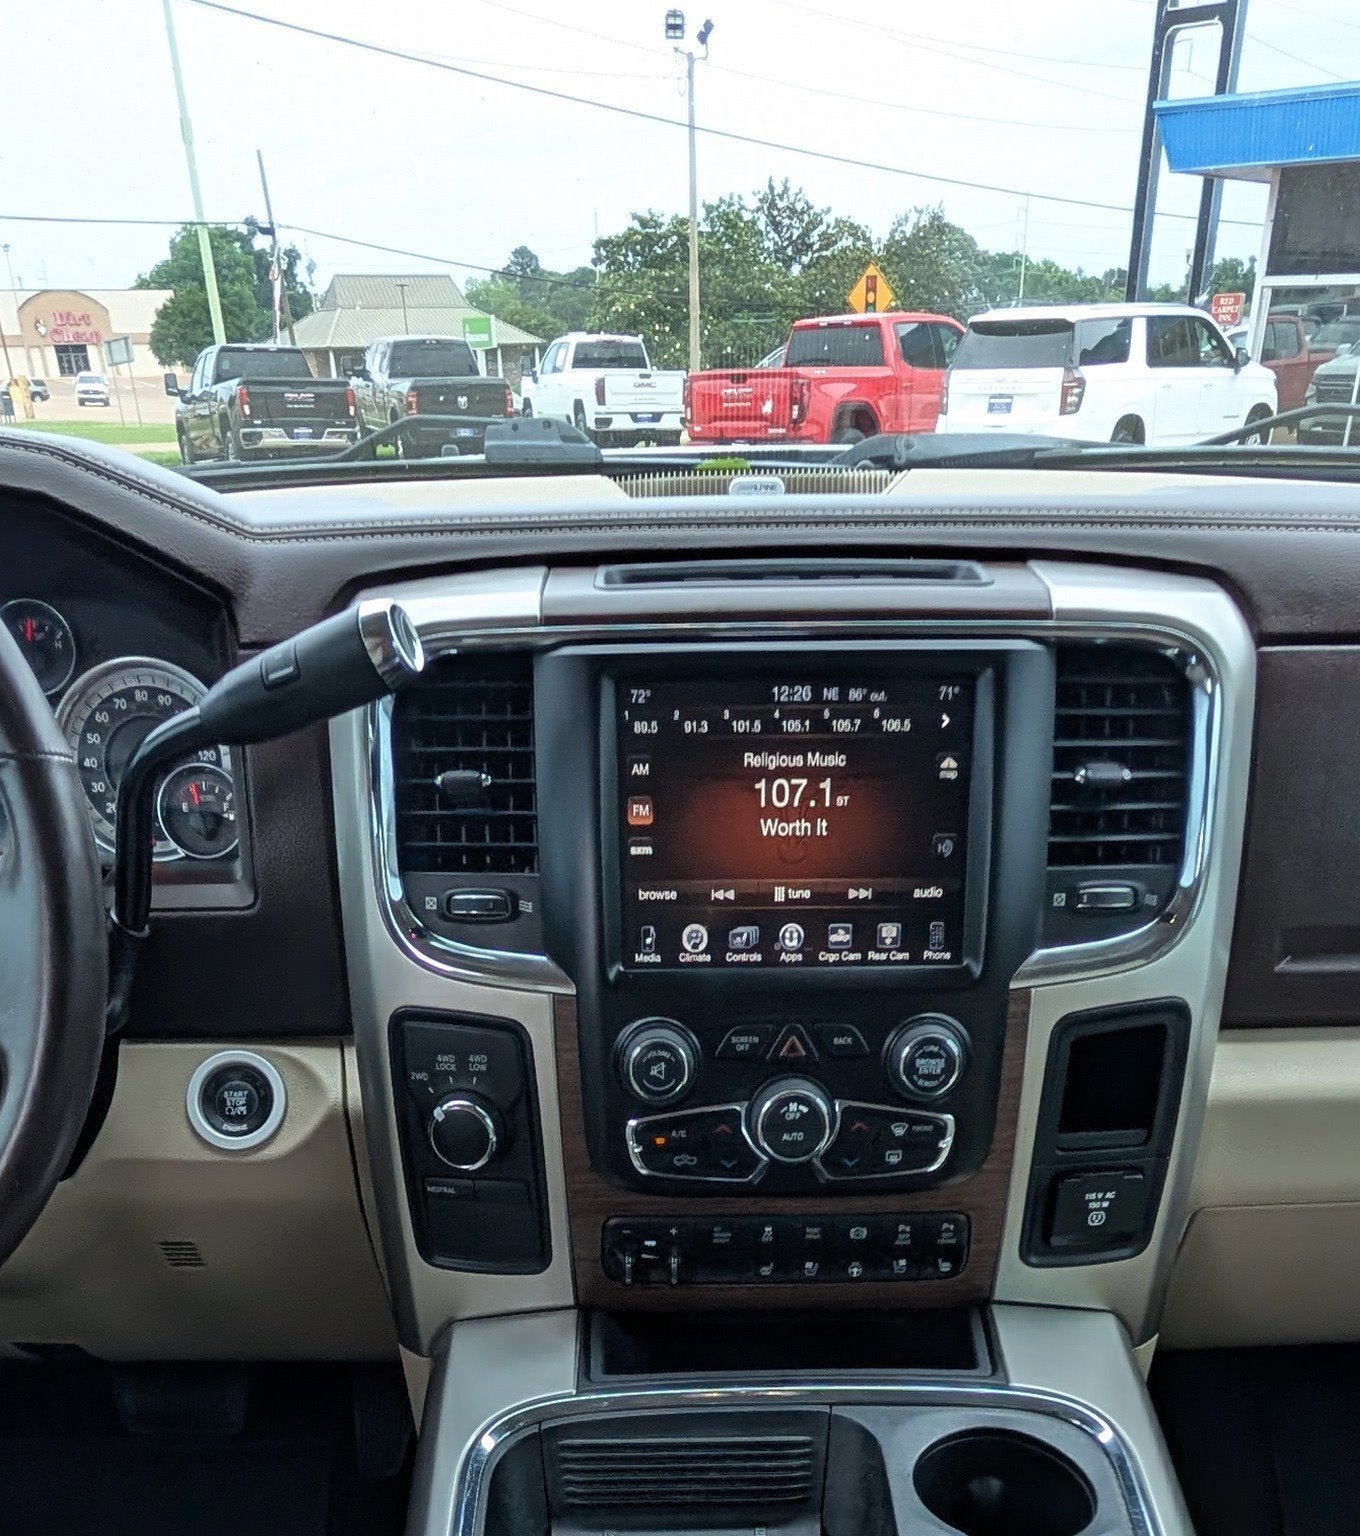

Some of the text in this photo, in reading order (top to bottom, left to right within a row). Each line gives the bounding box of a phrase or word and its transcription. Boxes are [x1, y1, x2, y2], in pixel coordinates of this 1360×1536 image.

[53, 311, 92, 326] Dirt
[50, 328, 102, 345] Cheap
[134, 690, 148, 702] 80
[157, 694, 172, 706] 90
[112, 698, 127, 710] 70
[95, 711, 109, 723] 60
[86, 733, 101, 744] 50
[198, 750, 217, 761] 120
[743, 750, 847, 770] Religious Music
[83, 757, 98, 768] 40
[632, 763, 650, 776] AM
[91, 781, 105, 793] 30
[754, 777, 832, 808] 107.1
[632, 804, 649, 816] FM
[759, 818, 828, 837] Worth It
[638, 888, 677, 900] browse
[787, 887, 811, 899] tune
[913, 885, 943, 899] audio
[635, 953, 661, 964] Media
[679, 952, 711, 963] Climate
[726, 952, 762, 963] Controls
[779, 952, 803, 964] Apps
[923, 949, 951, 961] Phone
[435, 1062, 457, 1071] LOCK
[223, 1090, 248, 1099] START
[226, 1098, 247, 1107] STOP
[782, 1132, 804, 1142] AUTO
